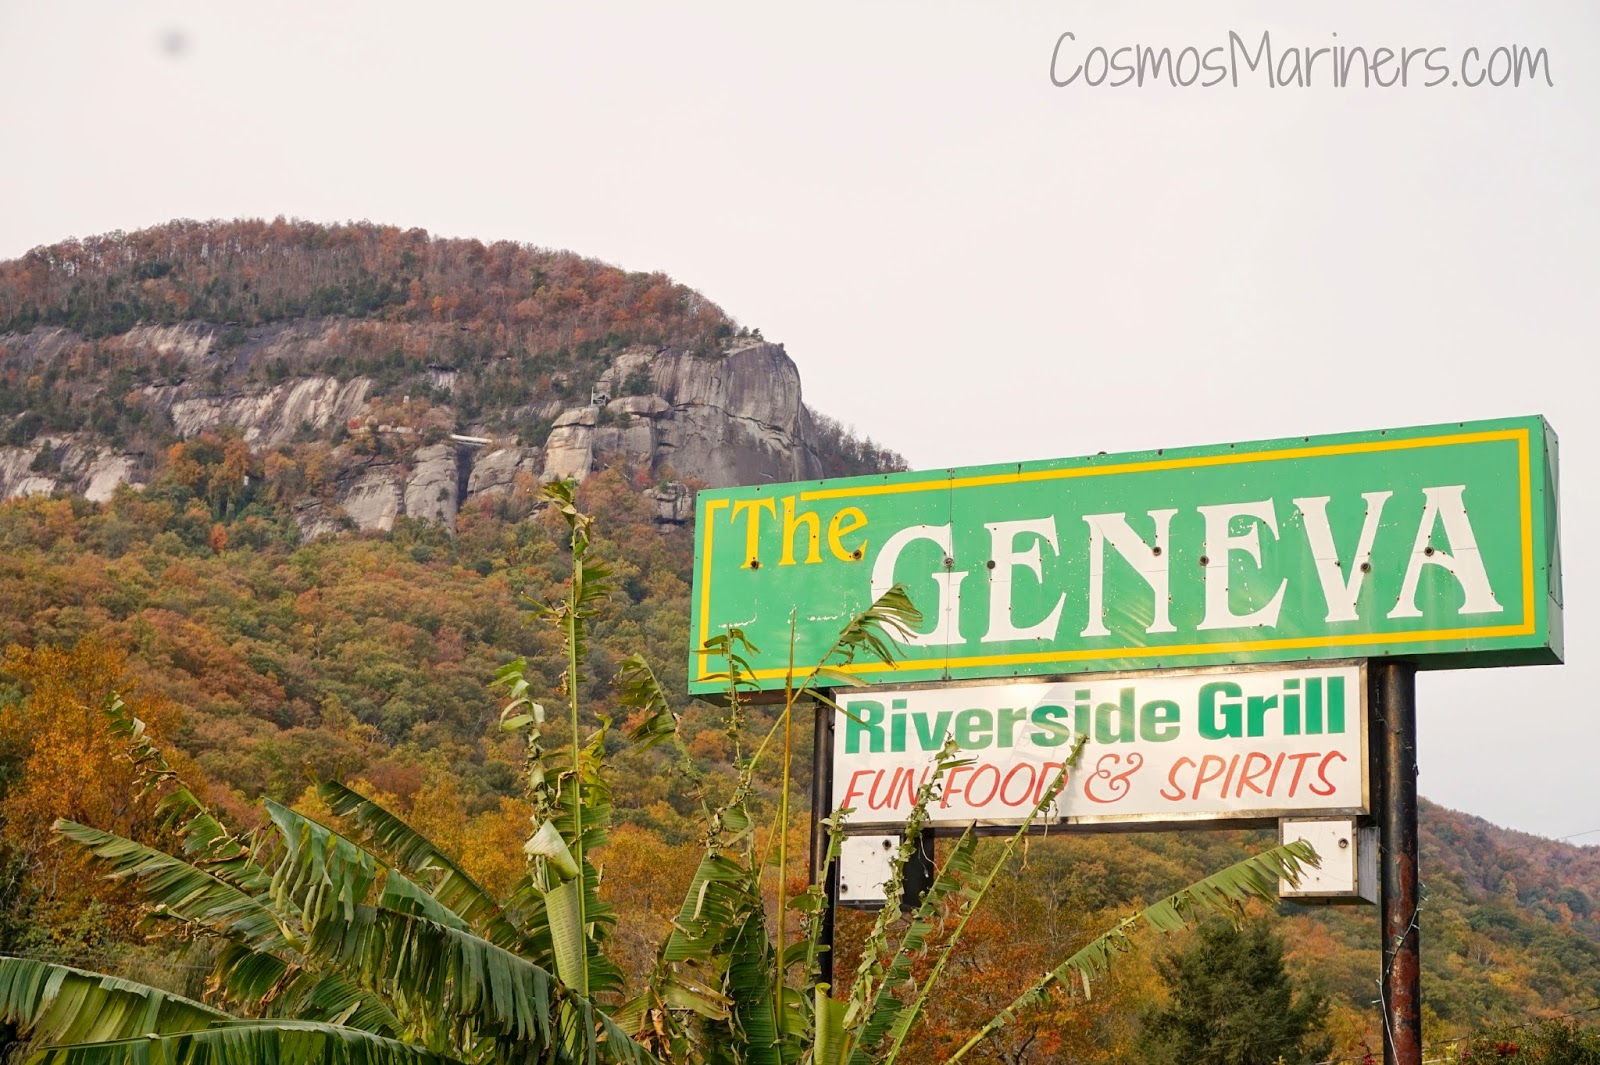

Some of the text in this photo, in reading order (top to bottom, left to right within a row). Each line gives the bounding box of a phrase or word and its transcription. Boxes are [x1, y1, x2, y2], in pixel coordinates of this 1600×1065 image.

[730, 495, 869, 570] The
[870, 484, 1504, 647] GENEVA
[845, 675, 1346, 754] Riverside Grill
[841, 750, 1347, 810] FUN FOOD & SPIRITS
